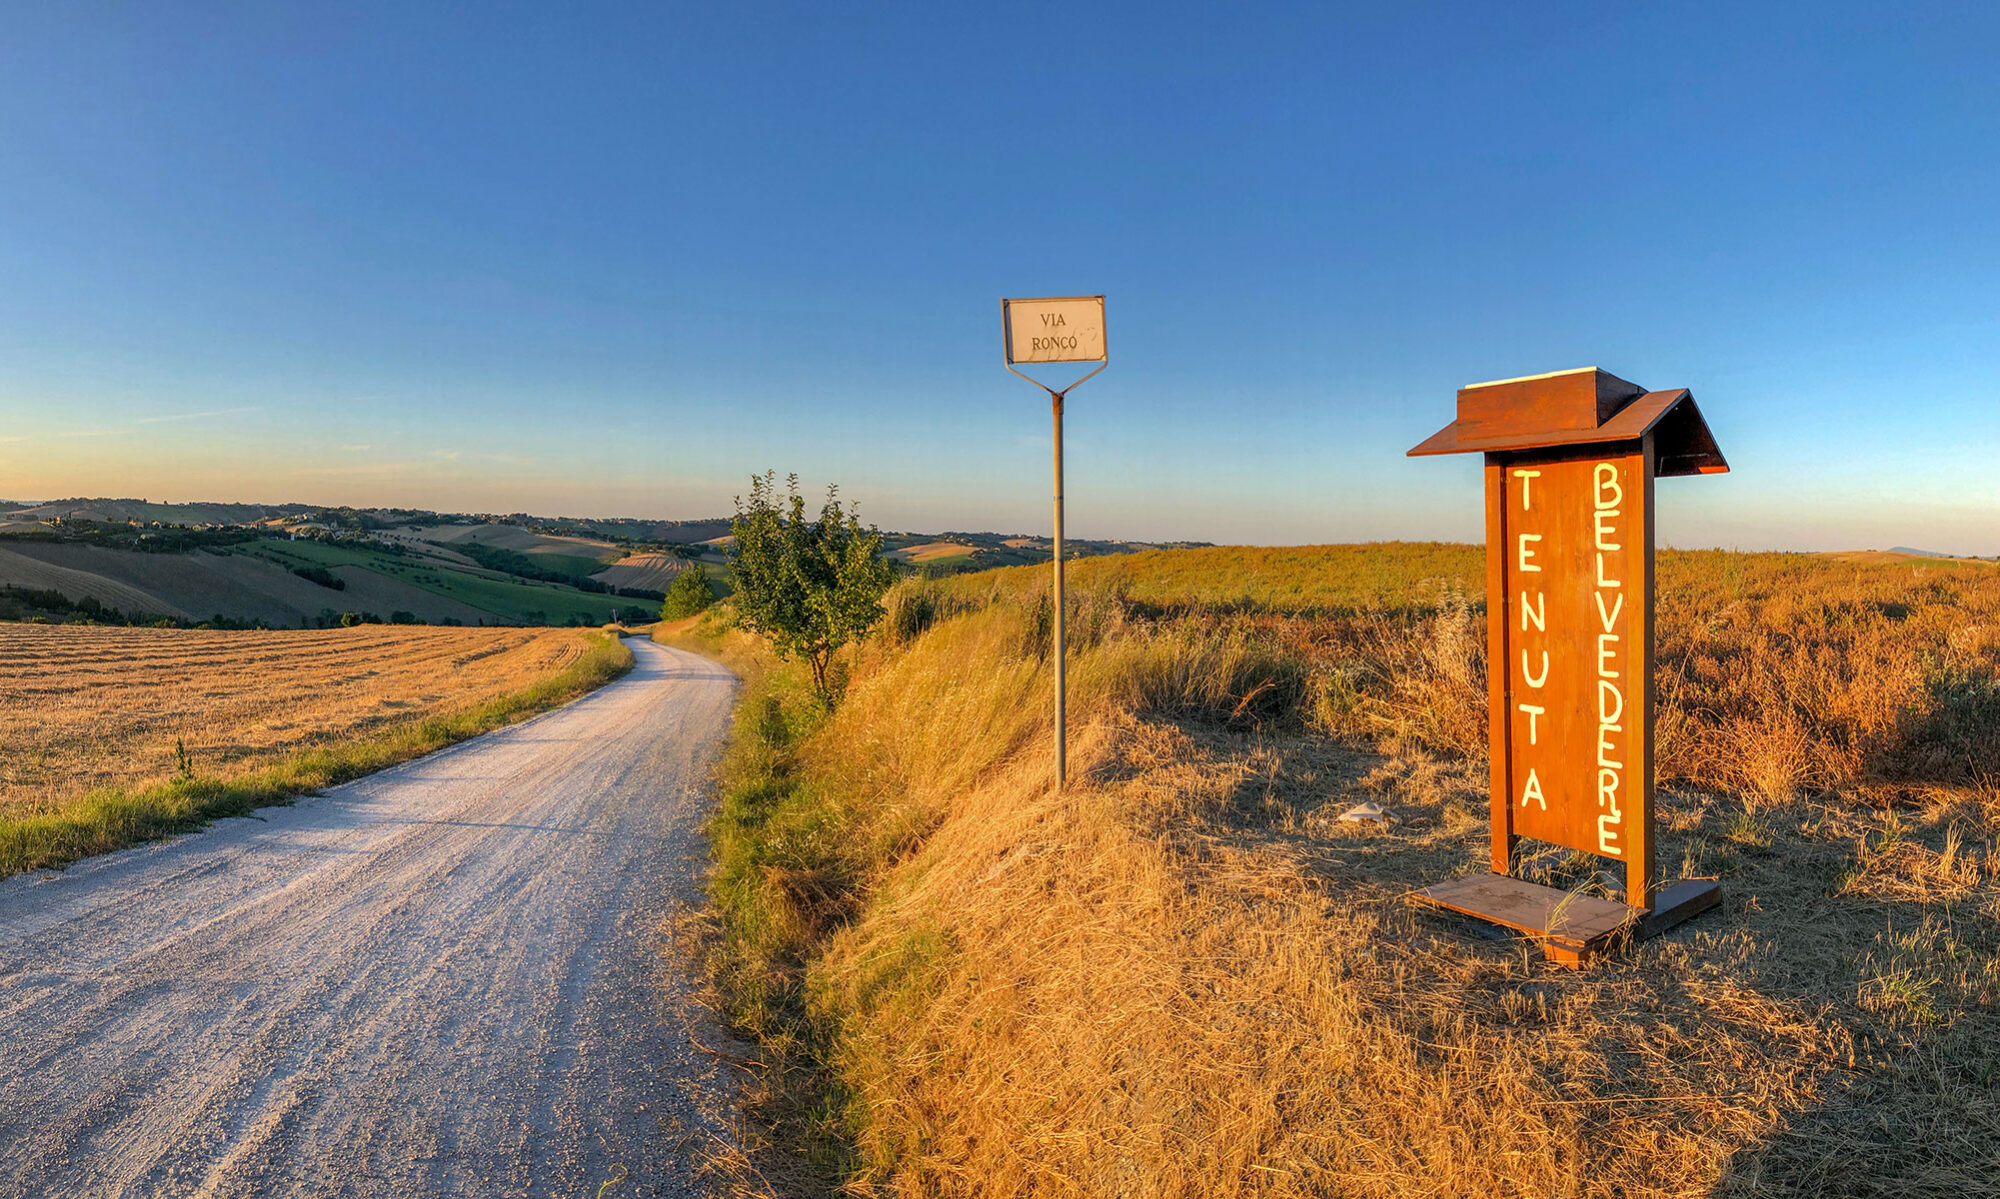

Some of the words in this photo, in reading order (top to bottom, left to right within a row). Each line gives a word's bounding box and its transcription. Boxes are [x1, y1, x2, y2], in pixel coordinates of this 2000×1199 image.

[1032, 336, 1078, 351] RONCO
[1040, 313, 1066, 326] VIA
[1513, 470, 1549, 811] TENUTA
[1593, 462, 1623, 854] BELVEDERE
